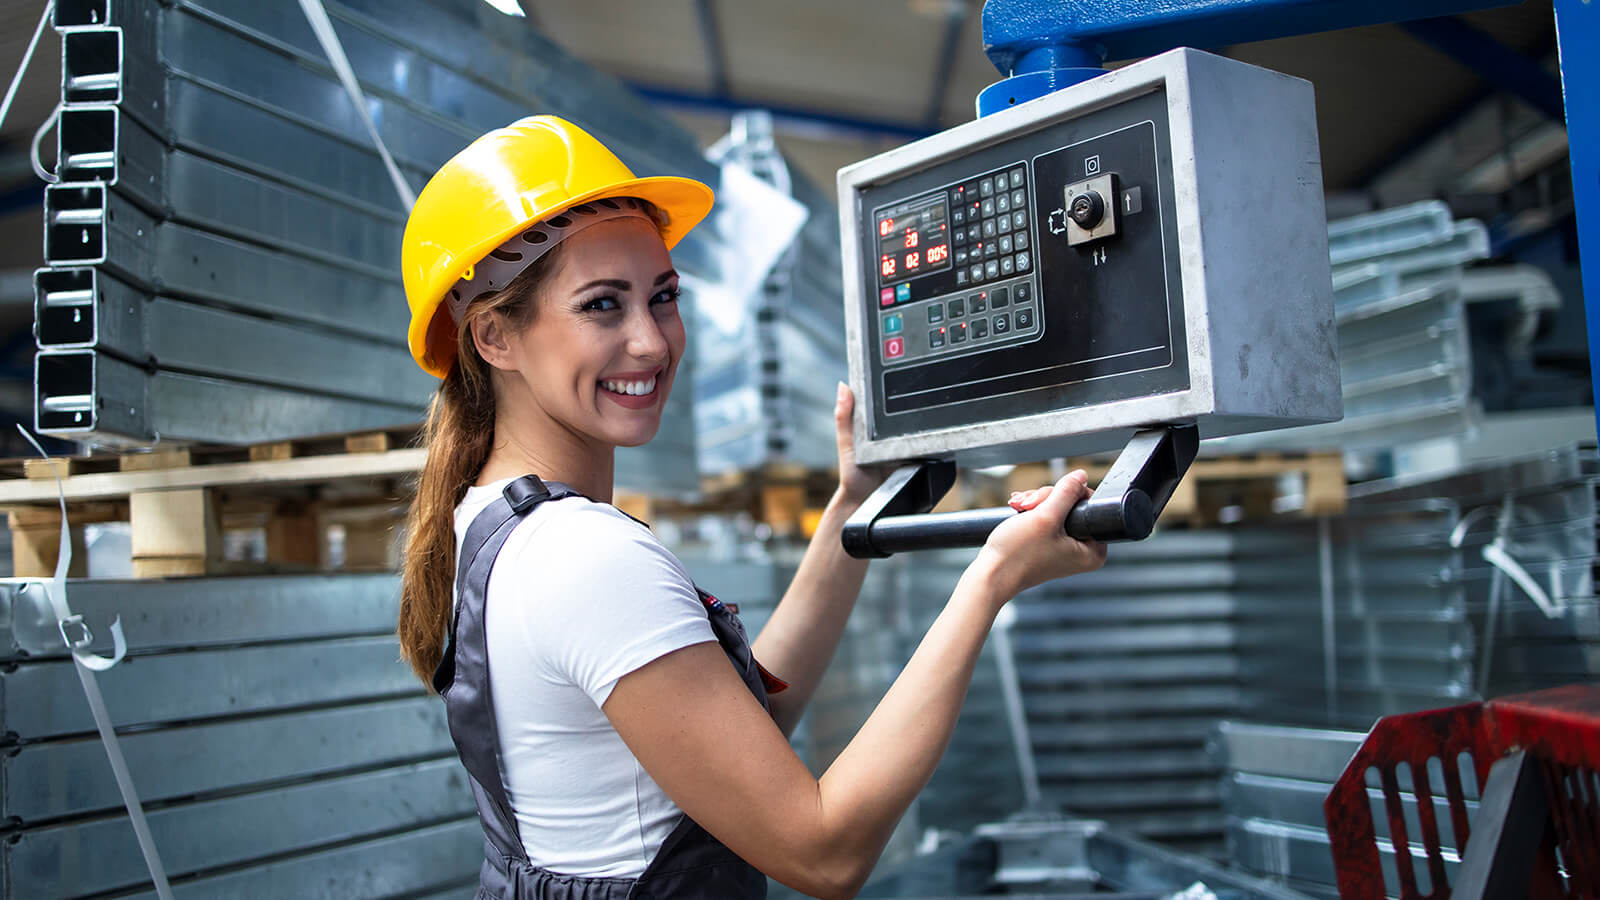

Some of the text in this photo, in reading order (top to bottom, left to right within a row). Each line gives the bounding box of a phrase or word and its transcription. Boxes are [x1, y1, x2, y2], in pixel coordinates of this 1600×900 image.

[984, 183, 989, 192] 7
[1000, 198, 1006, 207] 5
[1015, 194, 1021, 203] 6
[969, 208, 976, 217] P
[985, 204, 991, 212] 4
[954, 212, 963, 221] F2
[1016, 215, 1022, 224] 3
[1001, 219, 1008, 229] 2
[905, 231, 919, 248] 20
[956, 232, 964, 240] F3
[1003, 241, 1009, 250] 0
[882, 244, 948, 276] 02 02 005
[1004, 261, 1010, 270] C
